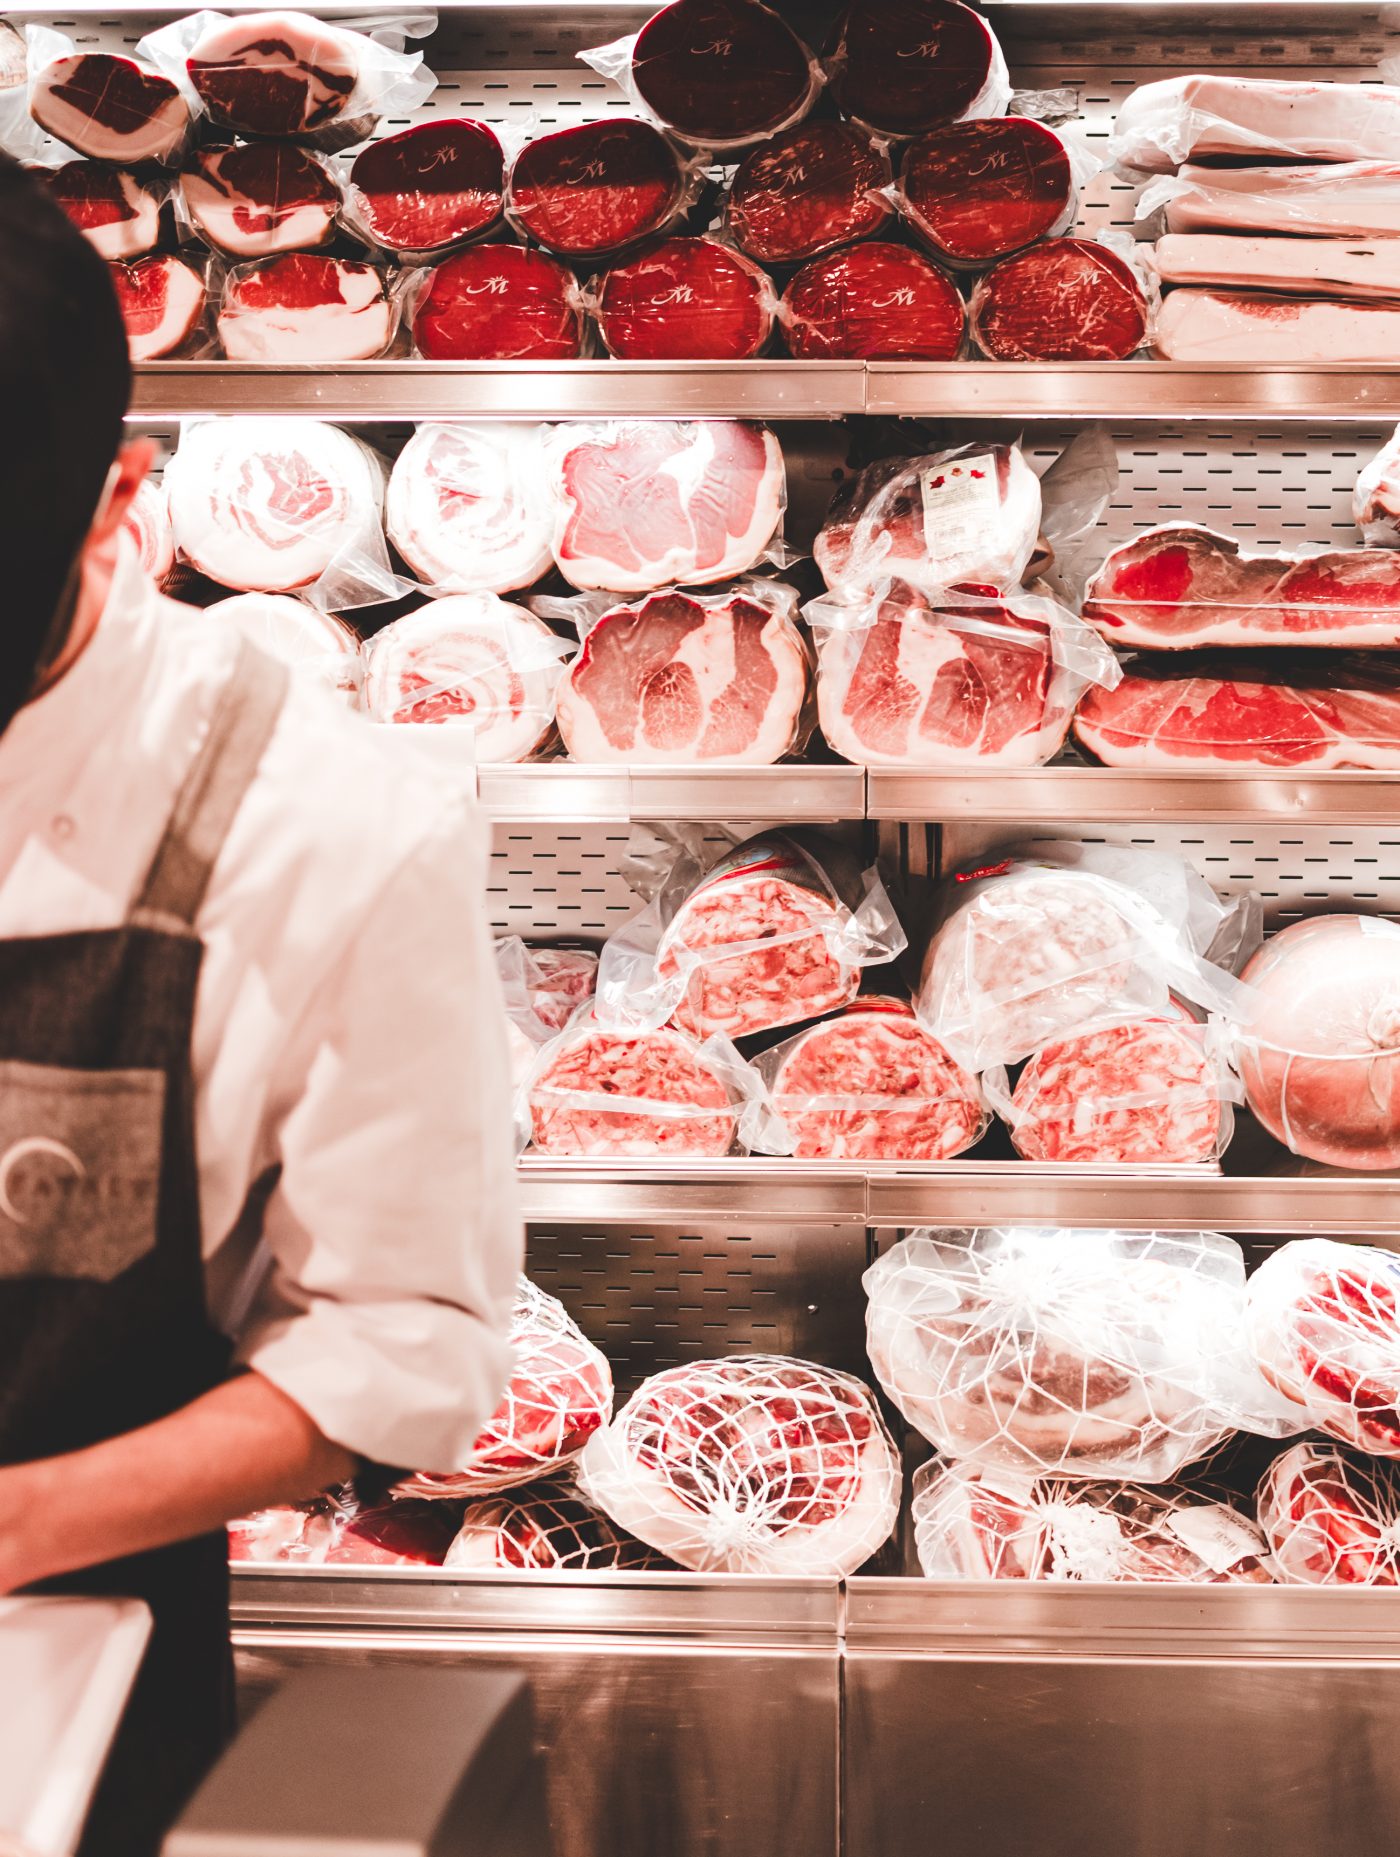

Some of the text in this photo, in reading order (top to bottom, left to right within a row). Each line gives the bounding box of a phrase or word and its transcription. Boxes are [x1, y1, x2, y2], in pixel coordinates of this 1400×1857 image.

[690, 38, 733, 56] M
[896, 39, 940, 58] M
[418, 145, 459, 173] M
[968, 149, 1009, 176] M
[566, 159, 608, 185] M
[768, 164, 808, 195] M
[466, 275, 509, 294] M
[1057, 267, 1105, 288] M
[651, 283, 694, 305] M
[872, 285, 916, 307] M
